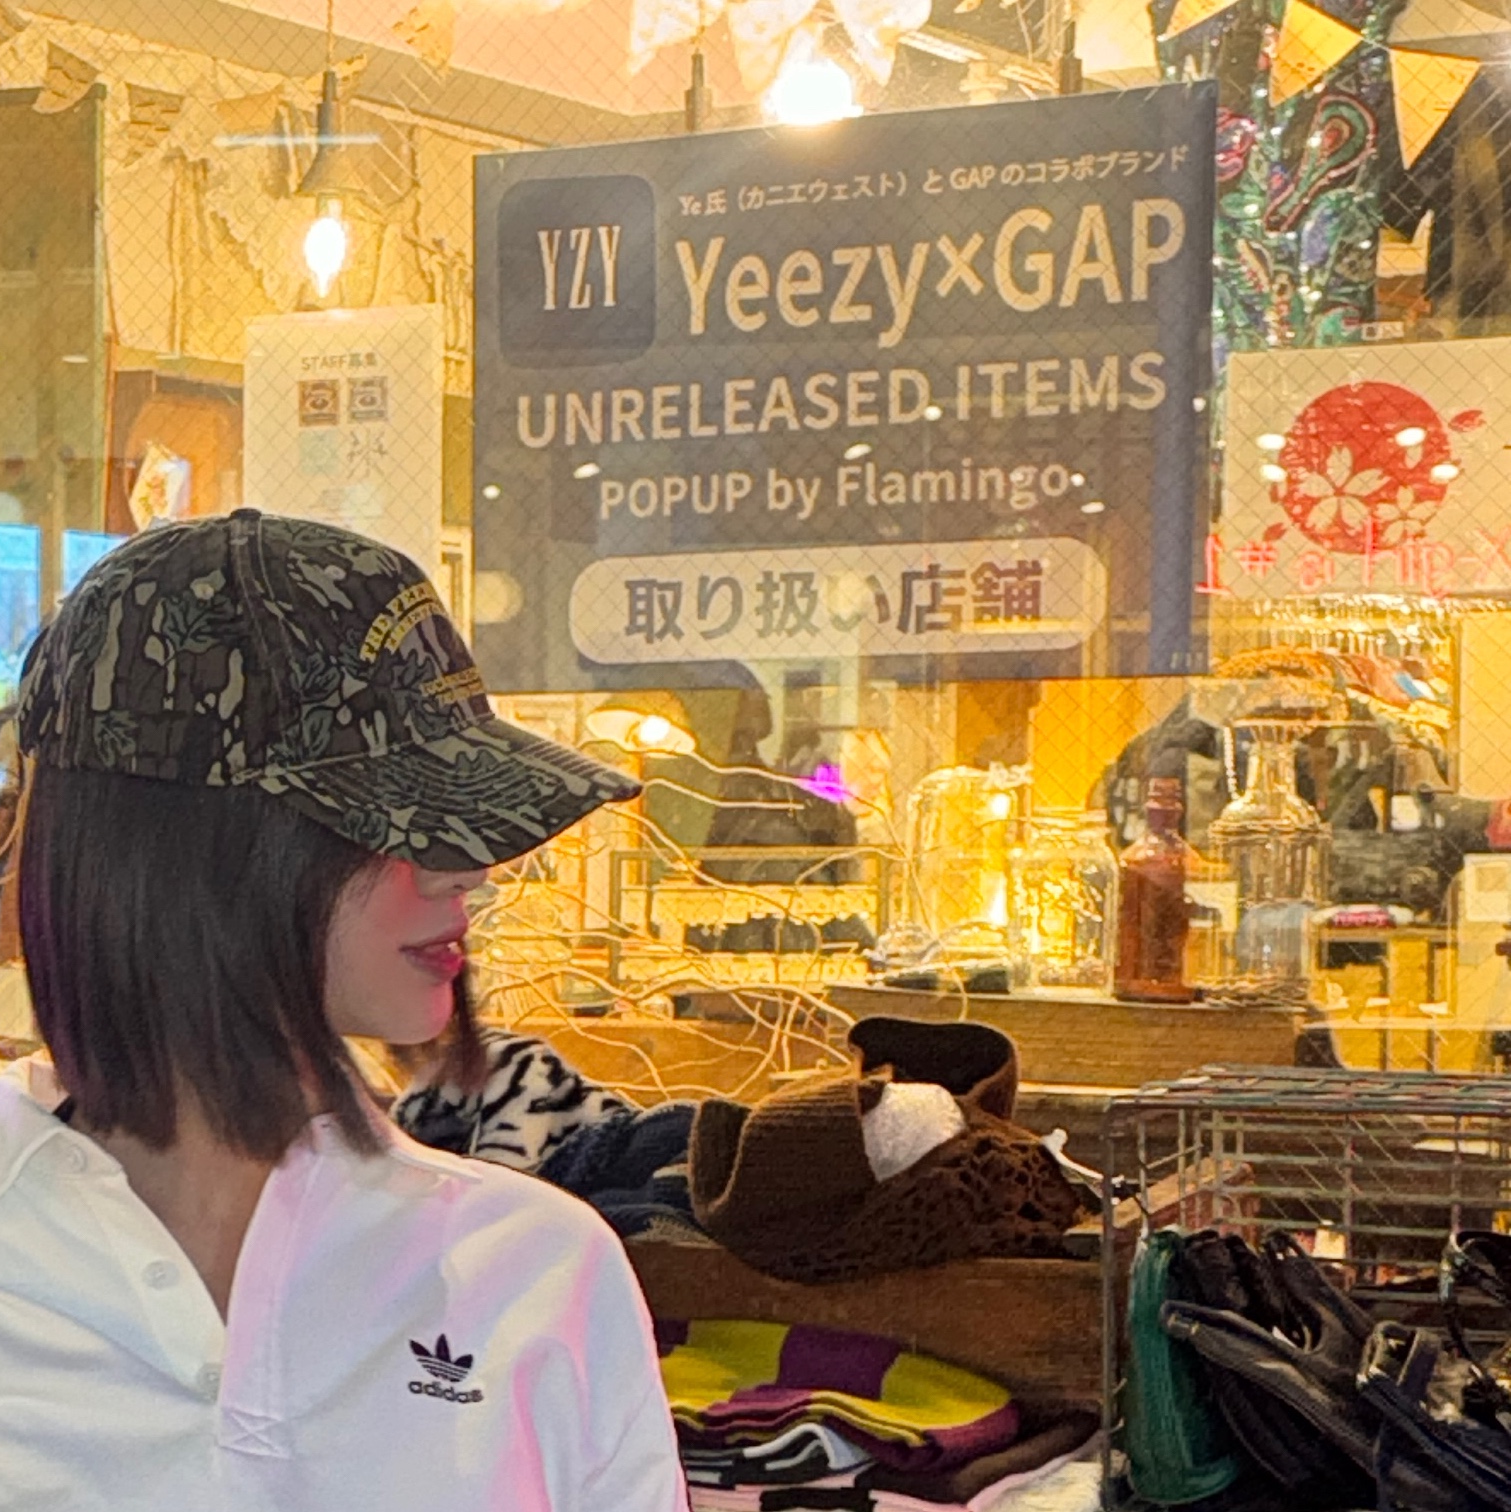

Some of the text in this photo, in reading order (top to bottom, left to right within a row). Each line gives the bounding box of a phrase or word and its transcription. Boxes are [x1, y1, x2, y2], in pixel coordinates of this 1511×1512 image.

[538, 225, 621, 311] YZY
[517, 351, 1168, 449] UNRELEASED ITEMS
[600, 457, 1071, 521] POPUP by Flamingo
[623, 559, 1044, 645] 取り扱い店舗
[408, 1380, 485, 1404] adidas
